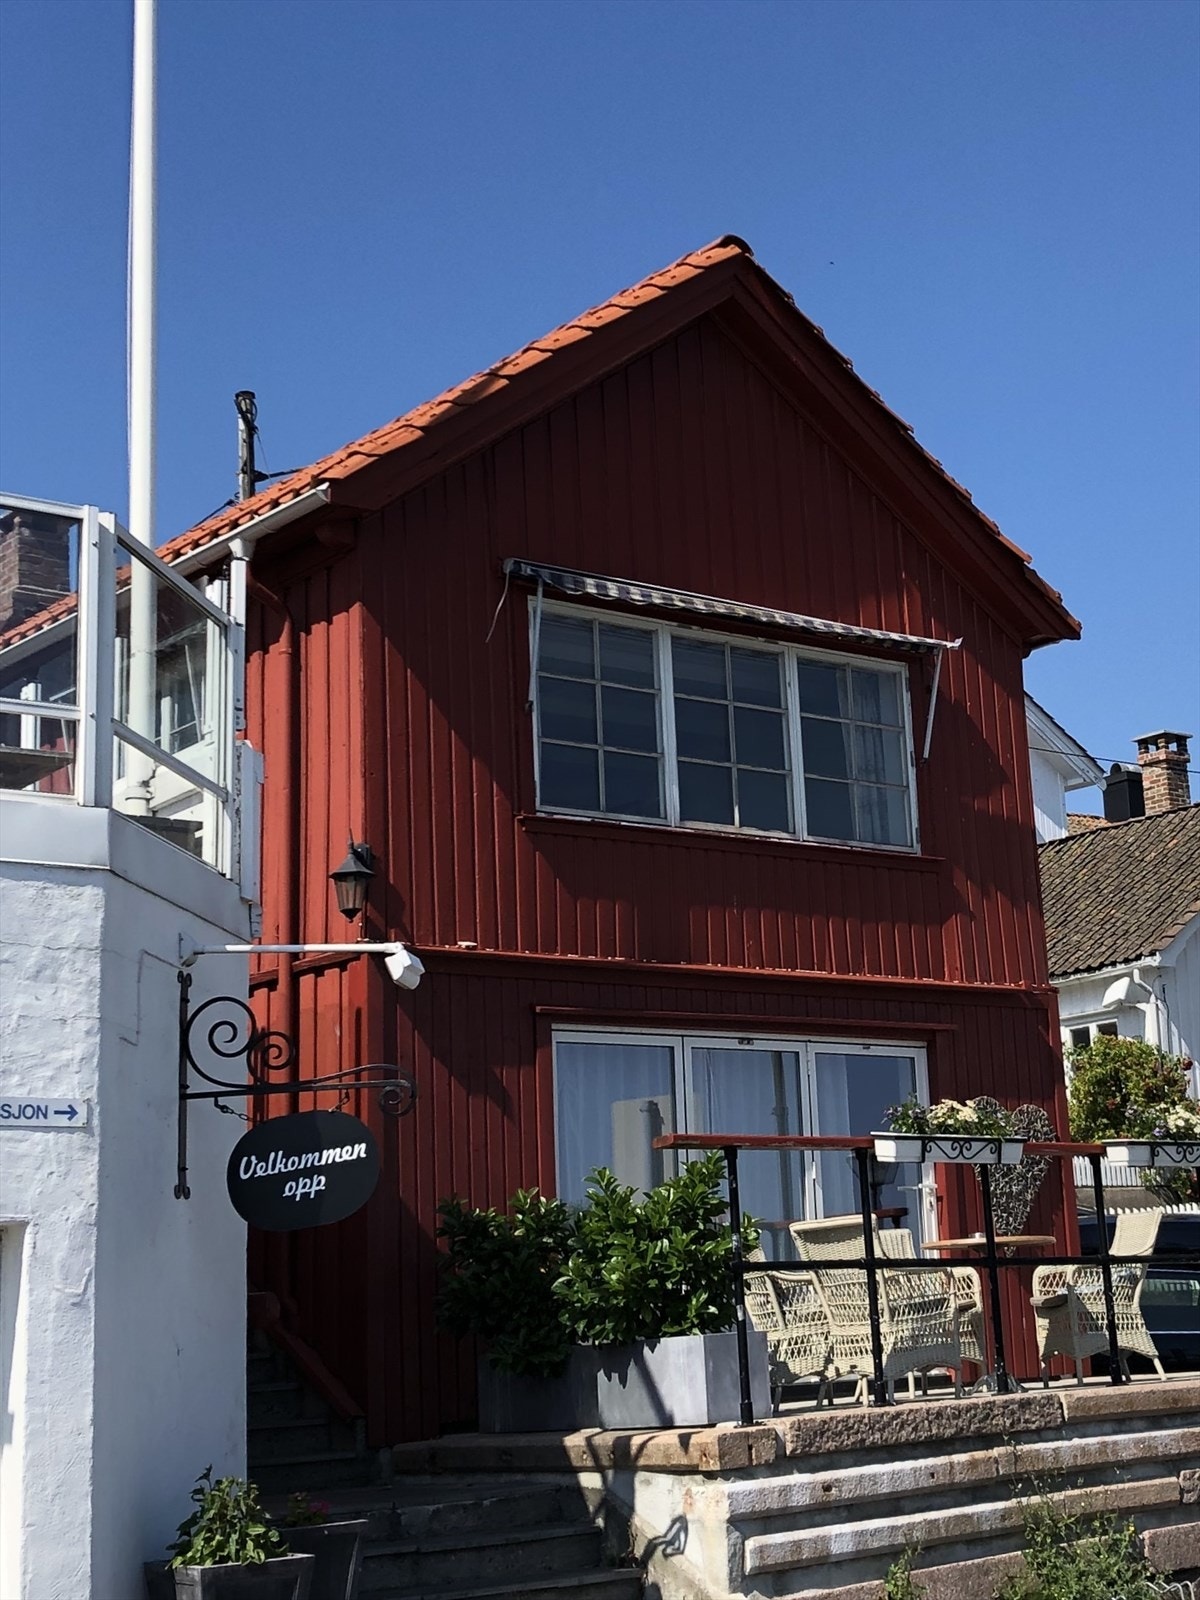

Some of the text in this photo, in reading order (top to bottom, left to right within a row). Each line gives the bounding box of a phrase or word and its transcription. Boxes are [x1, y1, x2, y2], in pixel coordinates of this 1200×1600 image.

[0, 1103, 48, 1120] SJON
[239, 1142, 367, 1181] Velkommen
[282, 1174, 326, 1202] opp
